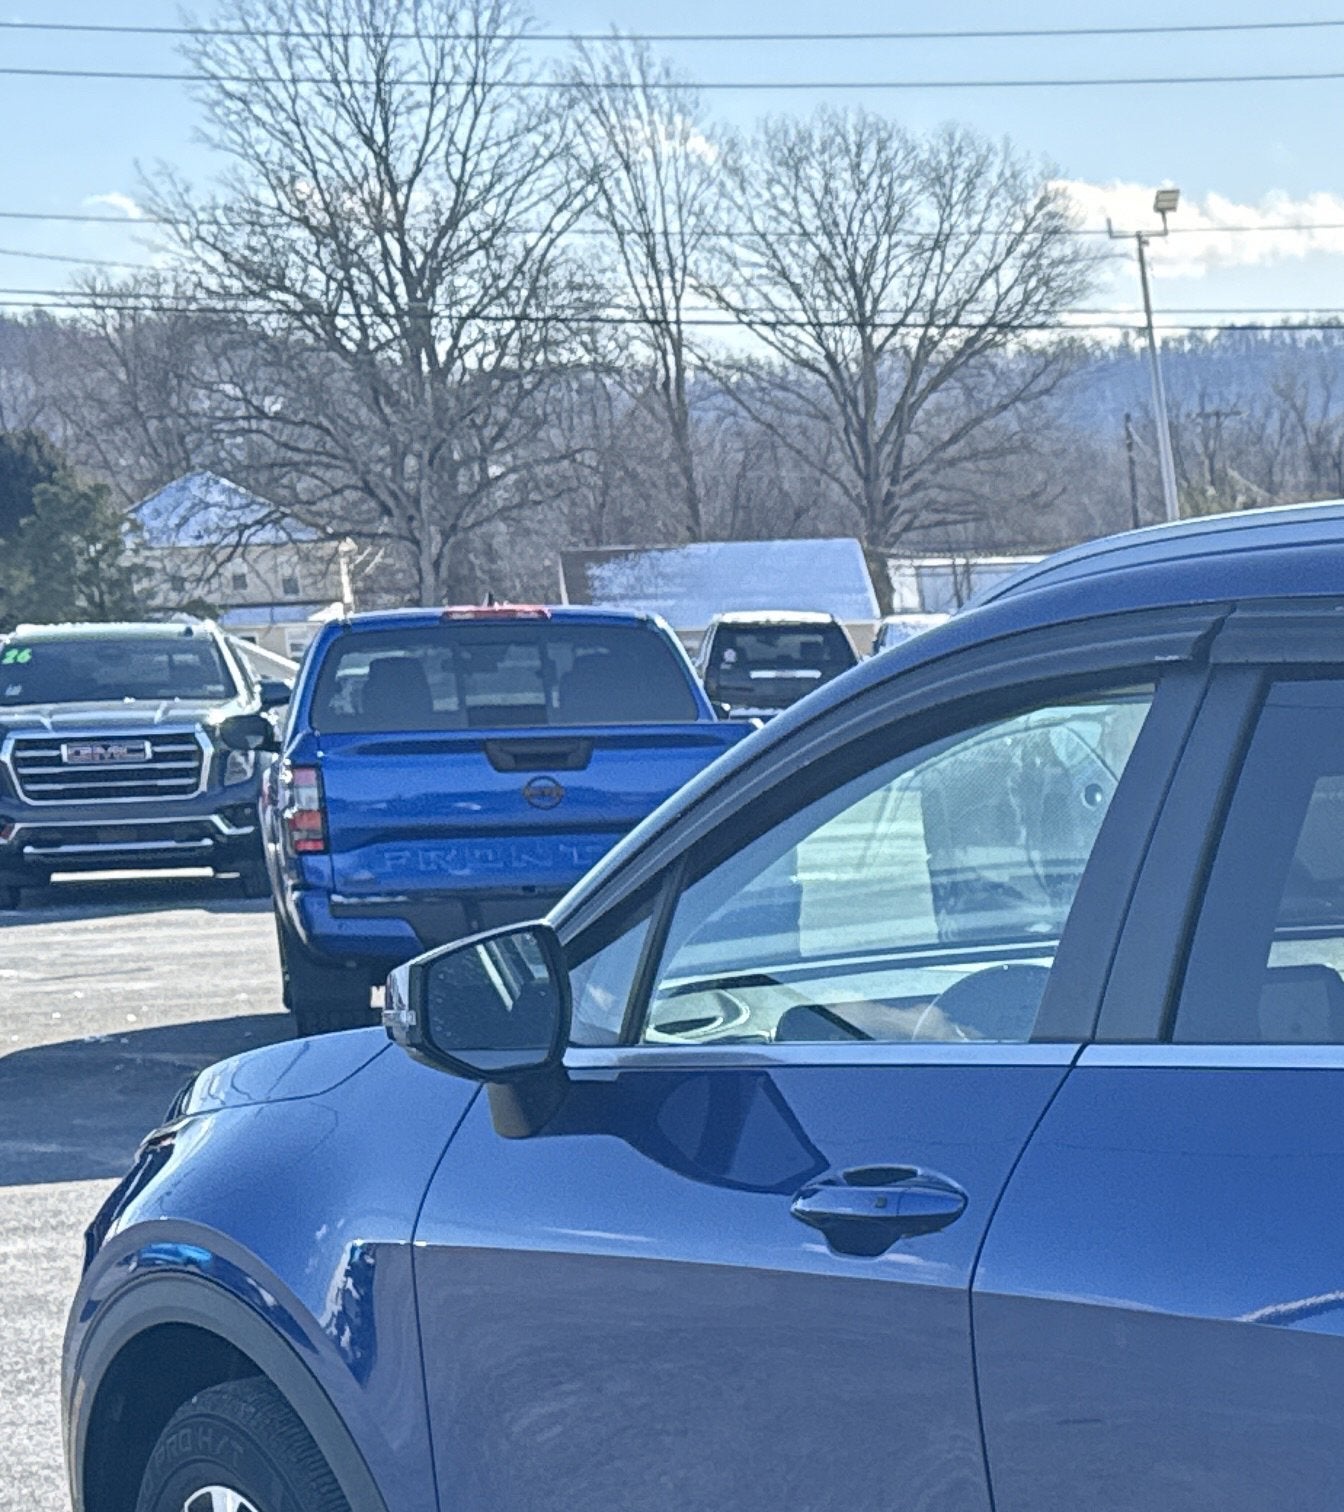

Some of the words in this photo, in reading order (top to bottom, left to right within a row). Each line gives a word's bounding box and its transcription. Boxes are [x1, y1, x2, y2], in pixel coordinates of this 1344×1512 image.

[2, 648, 32, 665] 26
[66, 743, 146, 762] GMC
[375, 843, 604, 872] FRONT
